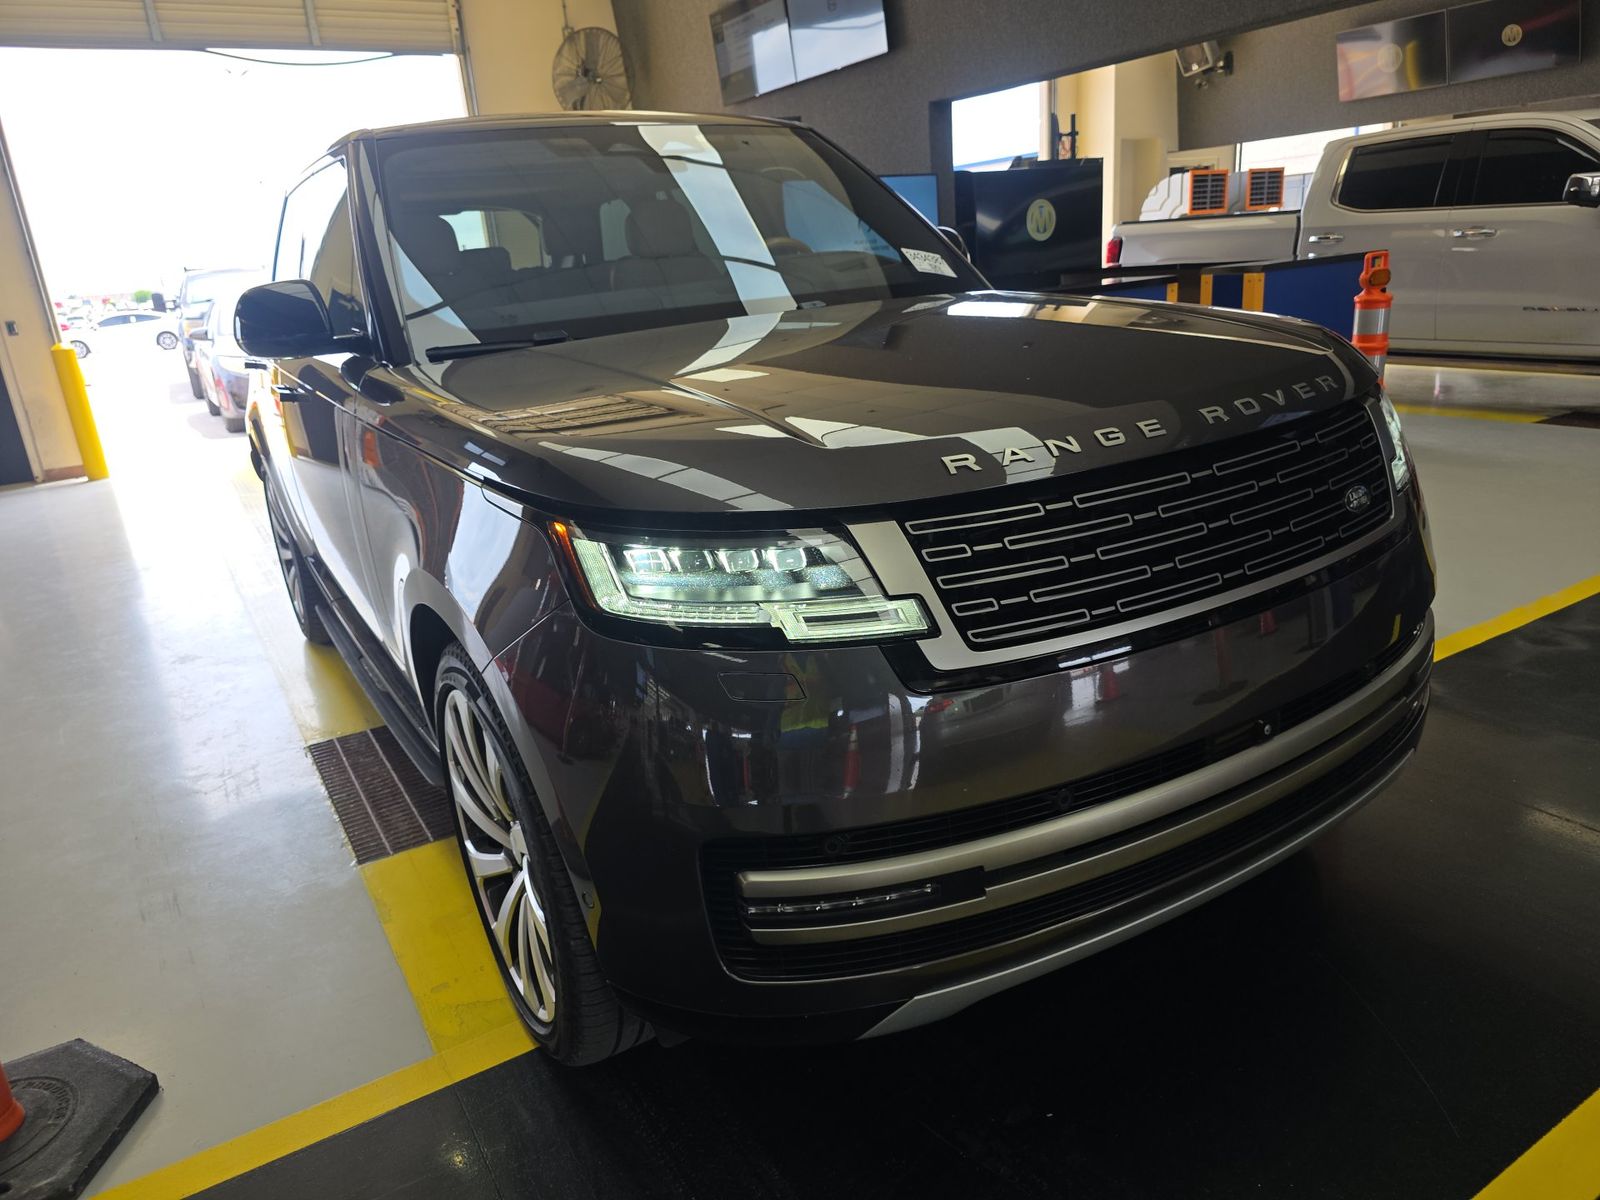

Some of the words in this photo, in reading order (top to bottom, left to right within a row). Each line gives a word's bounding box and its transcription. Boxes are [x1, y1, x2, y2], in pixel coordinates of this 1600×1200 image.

[1029, 202, 1054, 237] M
[941, 419, 1167, 475] RANGE
[1198, 375, 1339, 425] ROVER
